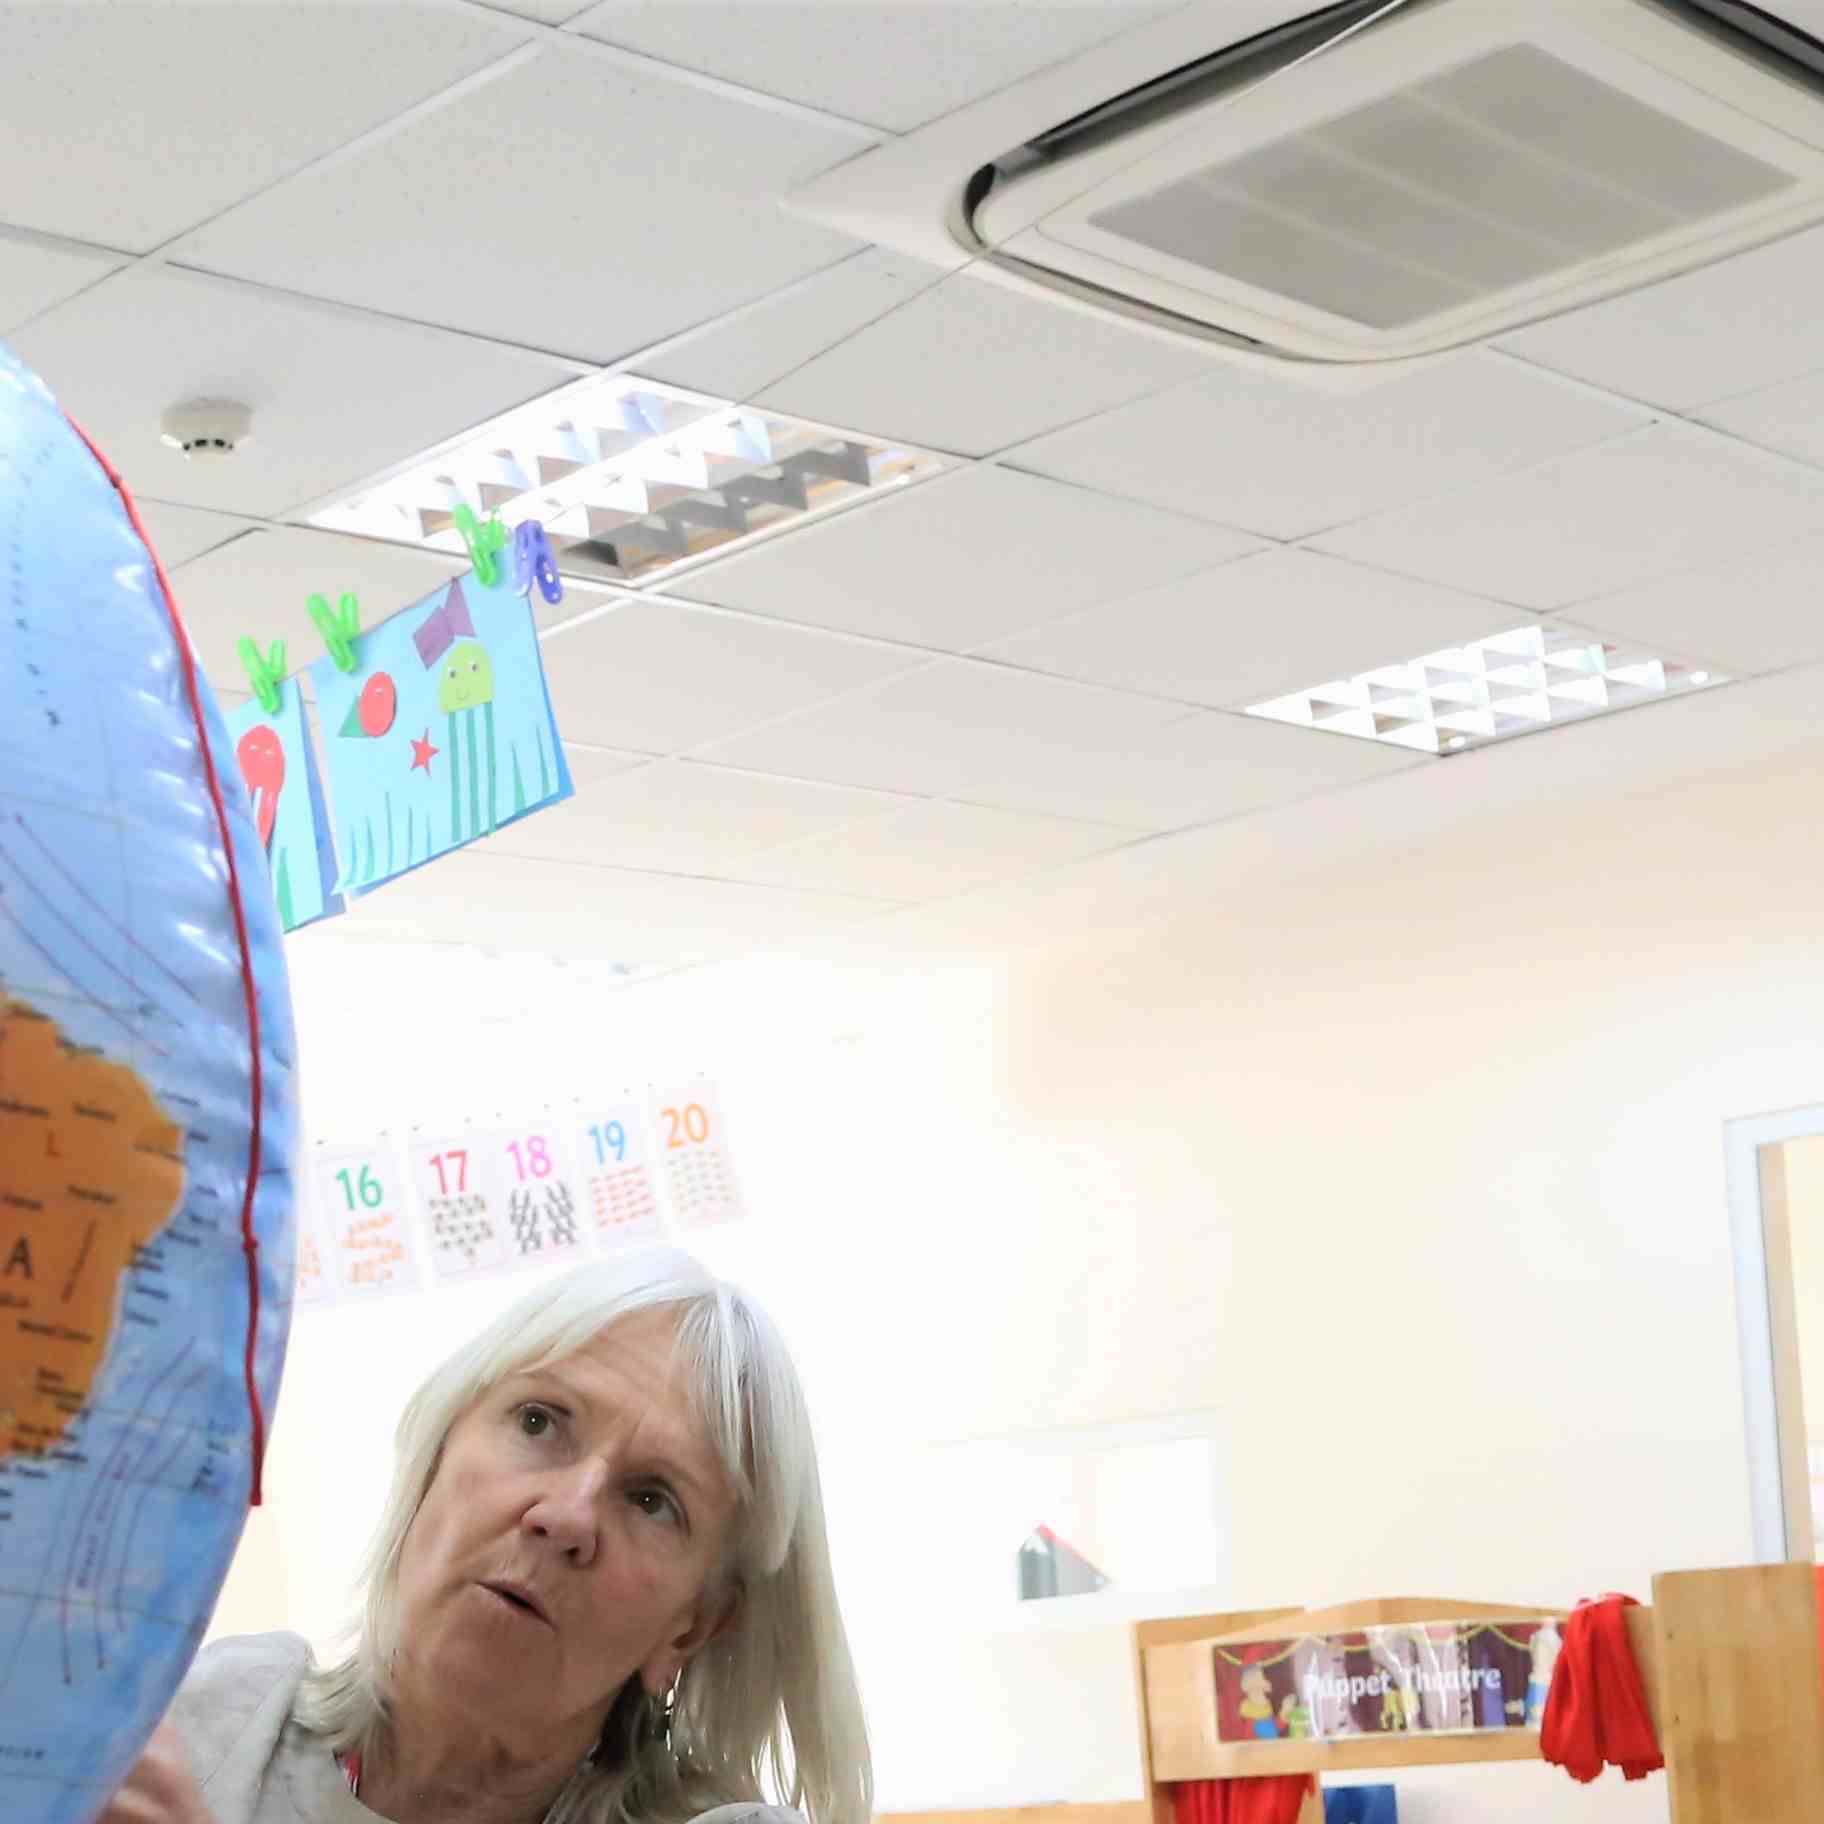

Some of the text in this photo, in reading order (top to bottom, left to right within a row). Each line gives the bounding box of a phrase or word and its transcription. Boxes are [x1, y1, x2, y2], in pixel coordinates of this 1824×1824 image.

[588, 1119, 626, 1166] 19
[661, 1103, 711, 1149] 20
[429, 1150, 470, 1195] 17
[506, 1135, 553, 1182] 18
[334, 1165, 384, 1211] 16
[1305, 1664, 1502, 1704] Puppet Theatre
